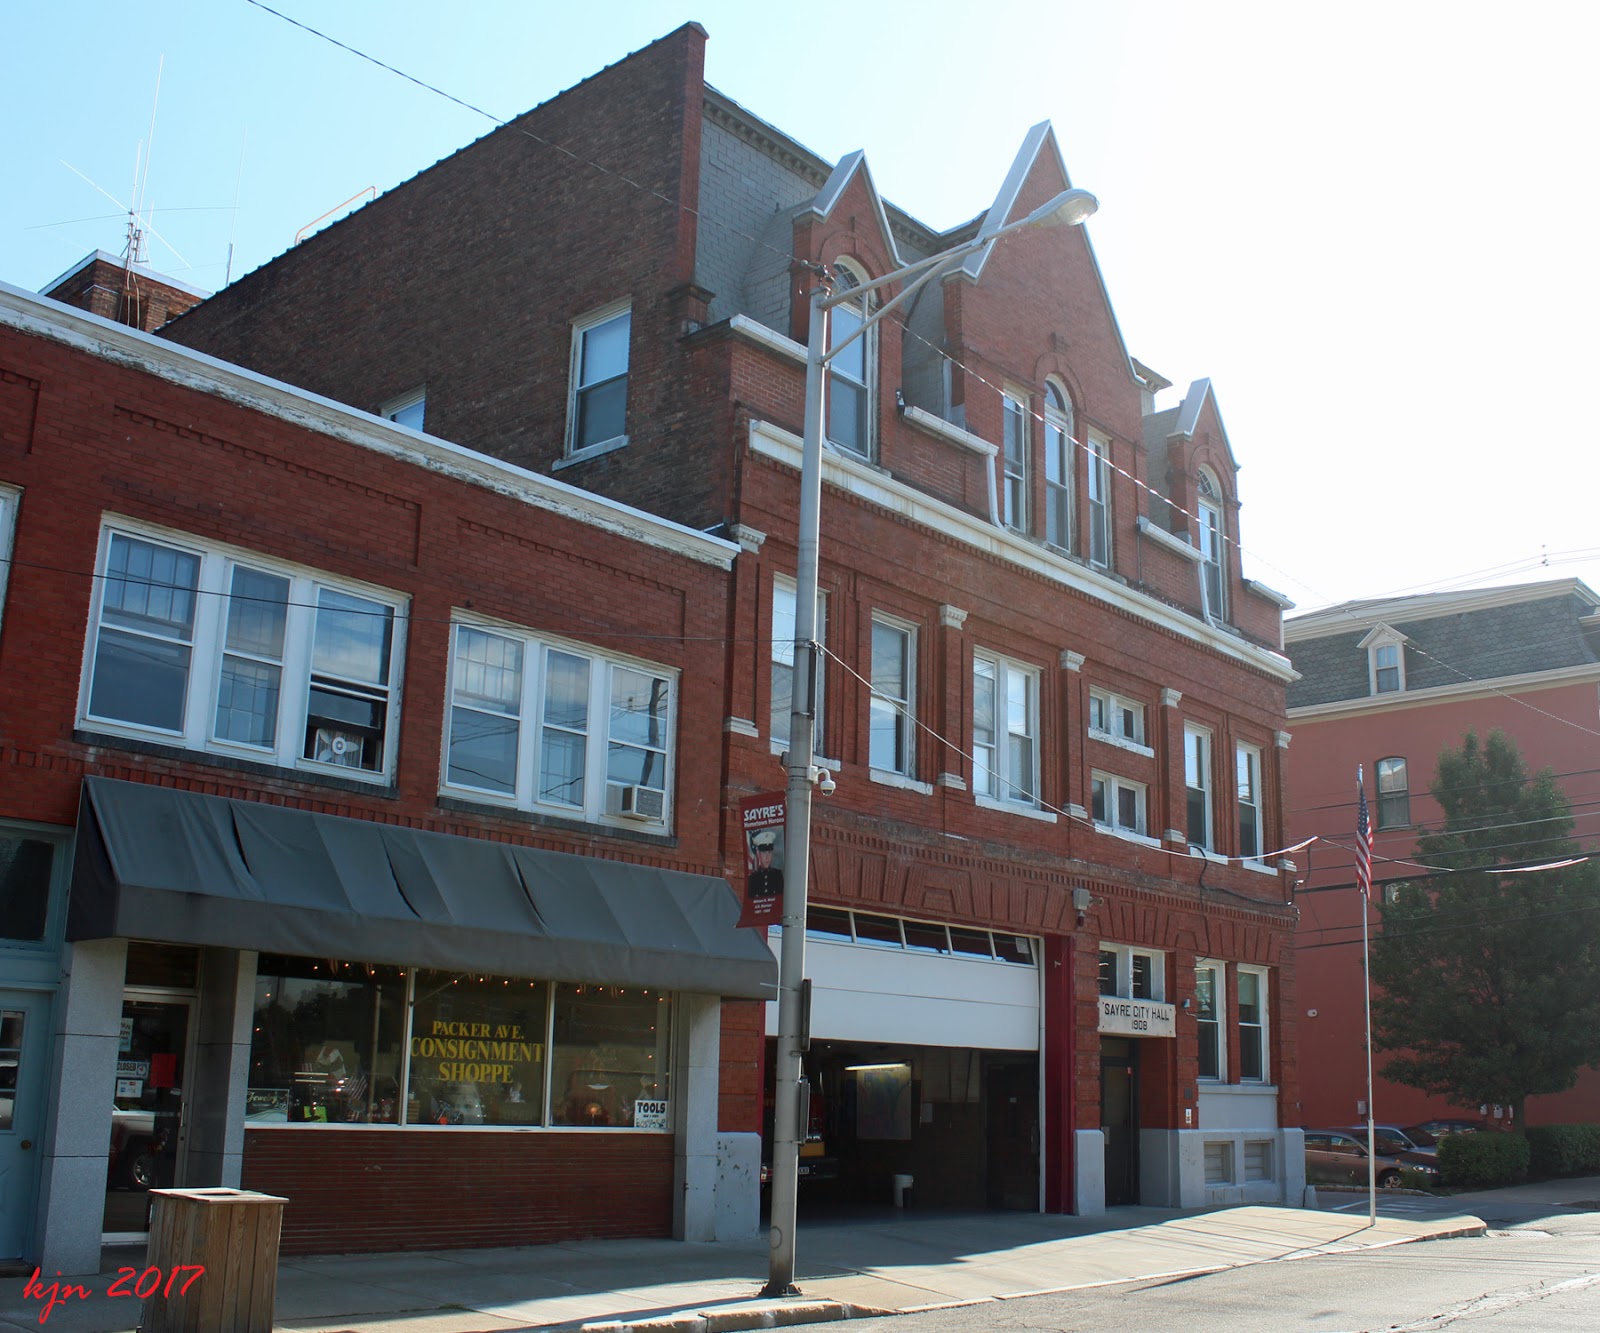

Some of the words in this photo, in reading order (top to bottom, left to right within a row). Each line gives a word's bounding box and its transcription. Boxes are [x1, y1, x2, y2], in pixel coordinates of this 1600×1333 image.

[744, 804, 783, 821] SAYRE'S
[1104, 1003, 1131, 1017] SAYRE
[1133, 1005, 1149, 1019] CITY
[1151, 1008, 1169, 1021] HALL
[432, 1020, 490, 1038] PACKER
[494, 1024, 525, 1040] AVE.
[1132, 1020, 1148, 1030] 1908
[411, 1036, 545, 1063] CONSIGNMENT
[117, 1062, 137, 1071] CLOSED
[439, 1061, 514, 1084] SHOPPE
[637, 1101, 666, 1114] TOOLS
